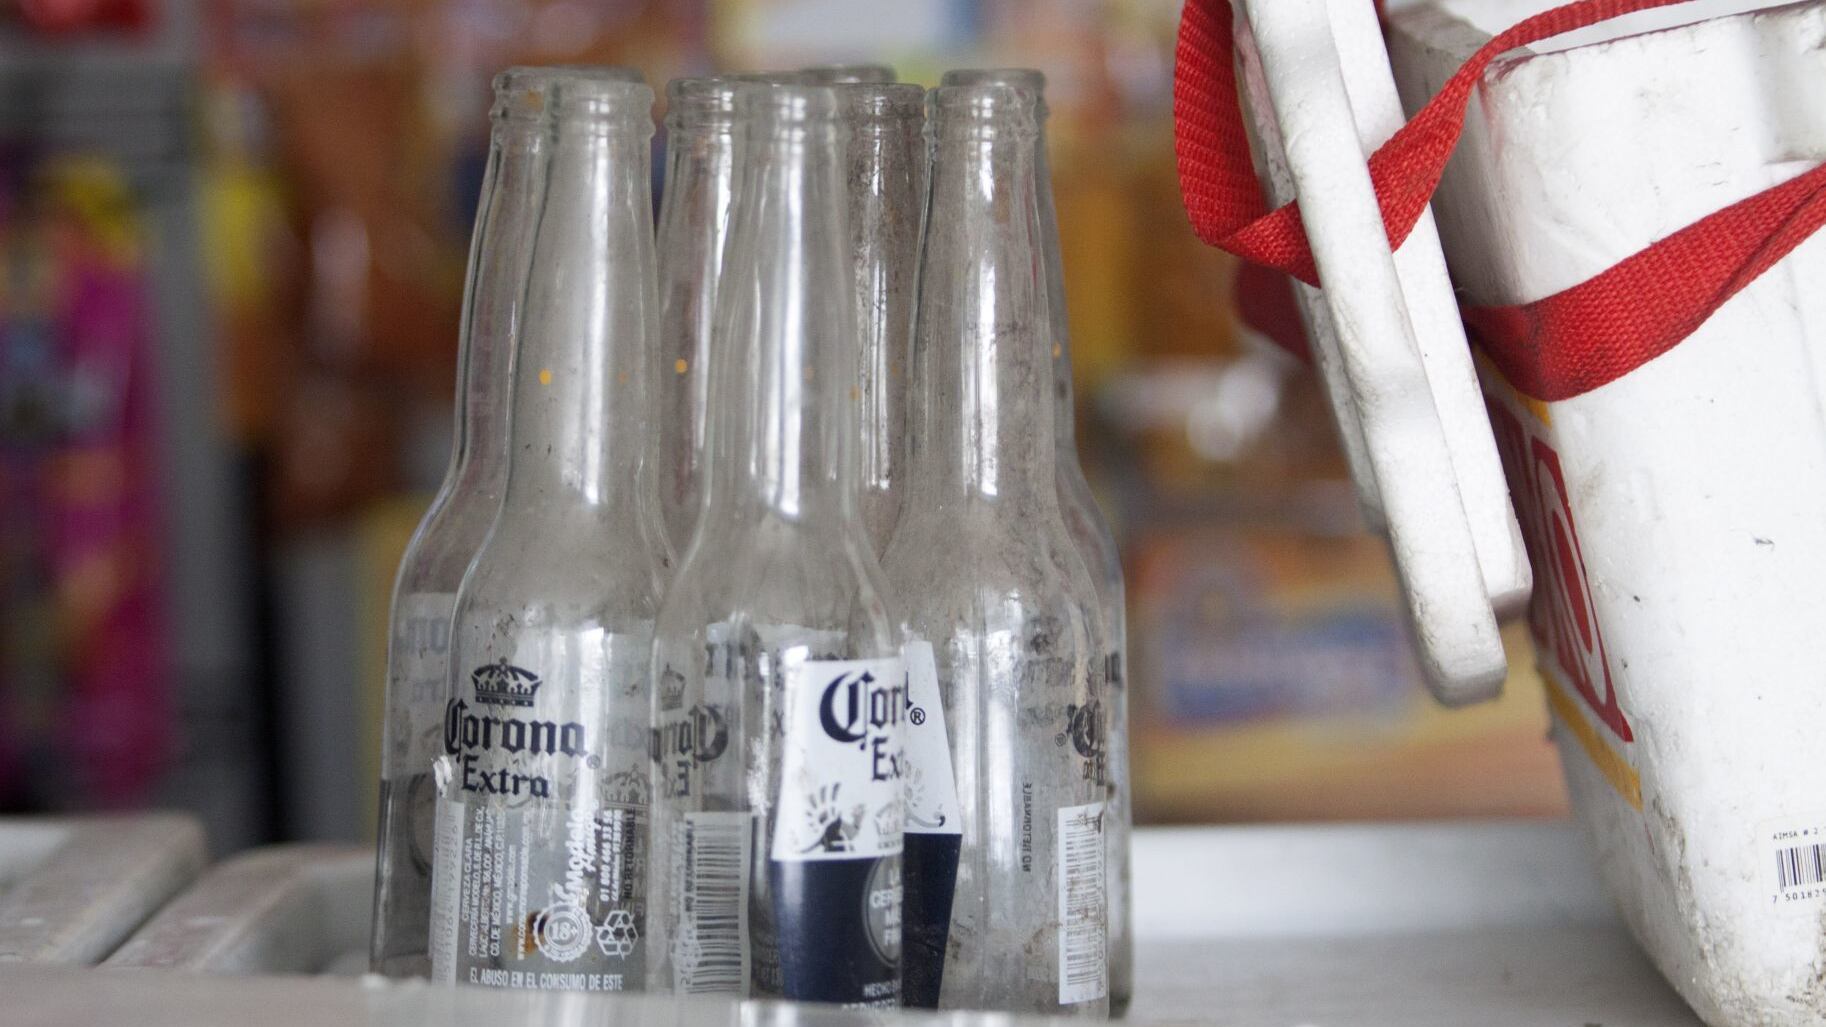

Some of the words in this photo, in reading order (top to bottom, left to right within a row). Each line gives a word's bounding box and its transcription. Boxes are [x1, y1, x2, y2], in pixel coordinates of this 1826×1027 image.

[444, 697, 588, 764] Corona
[462, 753, 550, 799] Extra
[465, 838, 473, 873] CLARA
[462, 875, 471, 922] CERVEZA
[480, 968, 509, 987] ABUSO
[511, 971, 523, 989] EN
[526, 972, 538, 990] EL
[540, 973, 586, 991] CONSUMO
[588, 974, 601, 991] DE
[603, 974, 624, 992] ESTE
